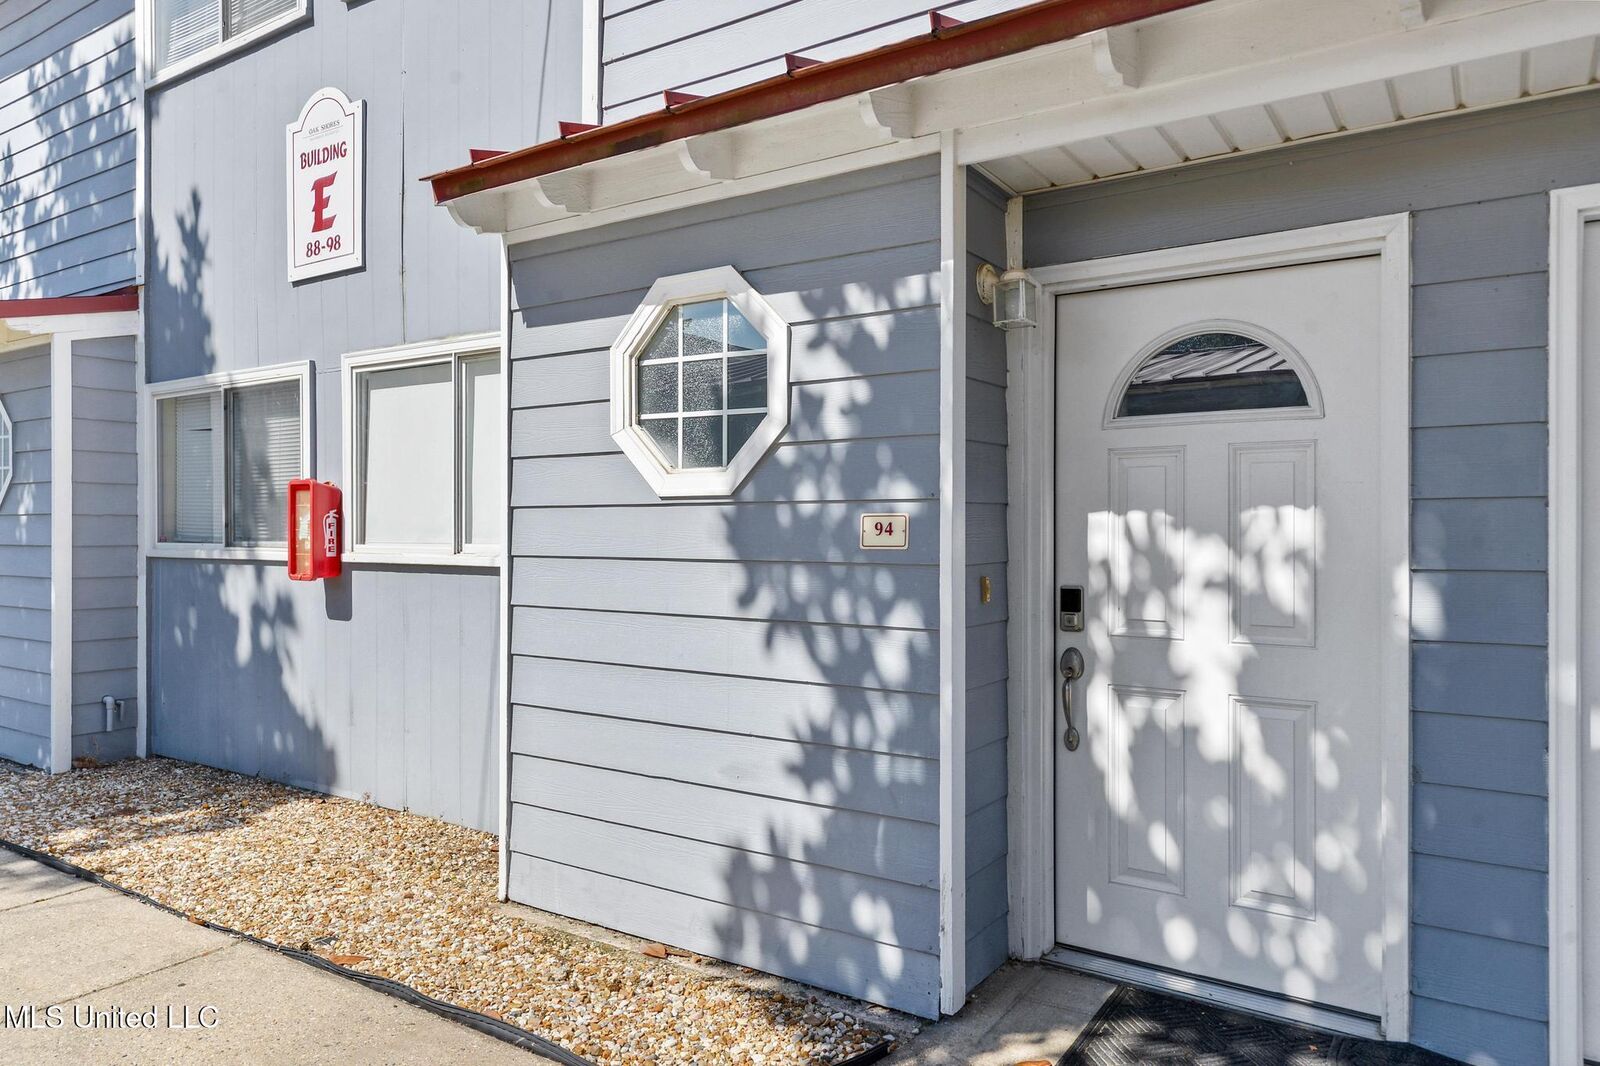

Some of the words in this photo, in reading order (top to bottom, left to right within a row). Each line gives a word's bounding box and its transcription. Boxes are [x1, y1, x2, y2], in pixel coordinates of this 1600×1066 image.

[308, 127, 320, 135] OAK
[321, 119, 340, 130] SHORES
[300, 141, 348, 169] BUILDING
[310, 170, 338, 233] E
[305, 234, 341, 258] 88-98
[327, 522, 335, 553] FIRE
[874, 521, 894, 537] 94
